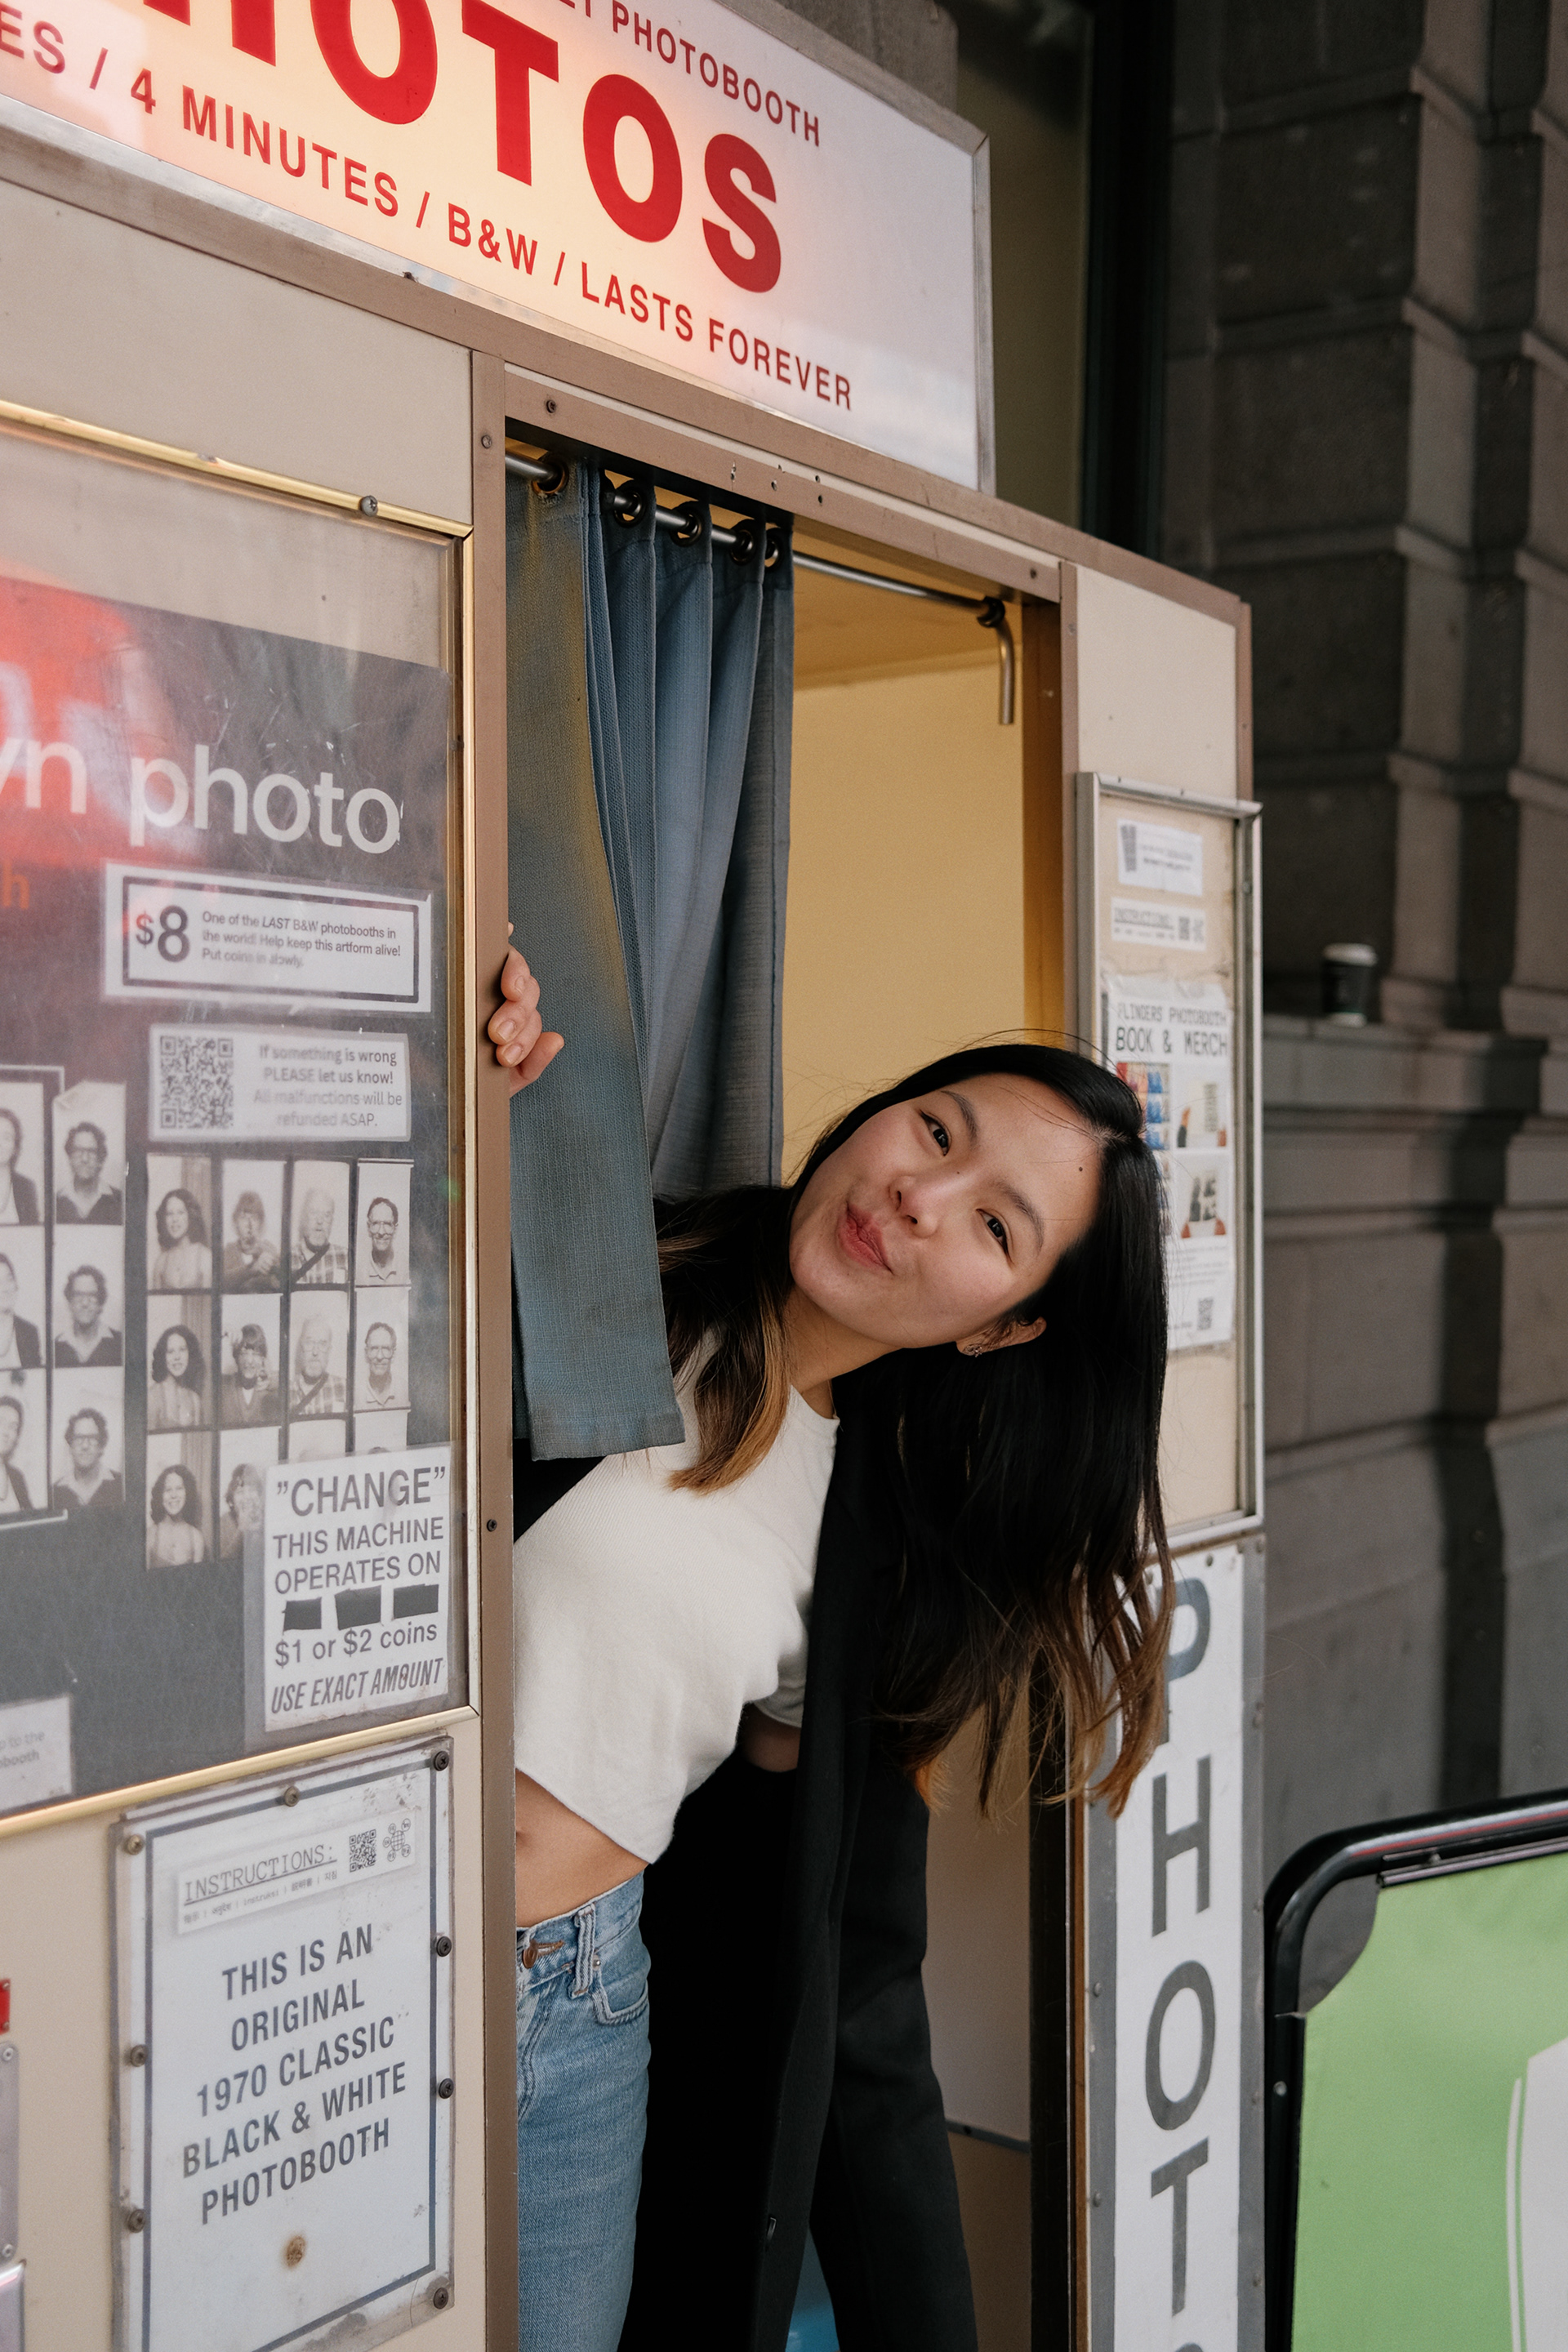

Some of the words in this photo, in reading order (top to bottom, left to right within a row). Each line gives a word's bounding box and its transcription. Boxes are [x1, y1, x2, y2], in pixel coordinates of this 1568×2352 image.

[612, 0, 819, 147] PHOTOBOOTH
[143, 0, 782, 294] OTOS
[131, 68, 157, 114] 4
[182, 85, 398, 217] MINUTES
[448, 203, 538, 275] B&W
[581, 261, 693, 342] LASTS
[709, 318, 852, 410] FOREVER
[131, 744, 400, 854] photo
[136, 905, 190, 963] $8
[203, 911, 225, 924] One
[229, 912, 239, 924] of
[242, 915, 259, 927] the
[262, 916, 290, 929] LAST
[293, 919, 318, 932] B&W
[321, 923, 385, 938] photobooths
[387, 928, 396, 939] in
[260, 934, 284, 948] Help
[287, 937, 312, 951] keep
[315, 939, 333, 951] this
[336, 942, 372, 955] artform
[376, 944, 401, 956] alive!
[202, 948, 221, 960] Put
[273, 1046, 342, 1065] something
[345, 1048, 355, 1062] is
[358, 1051, 398, 1067] wrong
[1116, 1026, 1153, 1053] BOOK
[1163, 1028, 1172, 1054] &
[1184, 1031, 1227, 1056] MERCH
[264, 1067, 315, 1082] PLEASE
[318, 1068, 336, 1083] let
[339, 1072, 354, 1084] us
[357, 1069, 394, 1085] know!
[363, 1091, 384, 1105] will
[387, 1091, 403, 1106] be
[340, 1112, 378, 1127] ASAP.
[273, 1529, 328, 1559] THIS
[336, 1517, 444, 1552] MACHINE
[274, 1556, 400, 1594] OPERATES
[408, 1551, 441, 1577] ON
[275, 1638, 301, 1668] $1
[313, 1639, 336, 1659] or
[343, 1628, 372, 1658] $2
[380, 1621, 437, 1649] coins
[271, 1682, 306, 1714] USE
[310, 1671, 369, 1707] EXACT
[370, 1657, 444, 1695] AMOUNT
[185, 1844, 333, 1902] INSTRUCTIONS:
[222, 1951, 288, 2002] THIS
[299, 1939, 326, 1979] IS
[336, 1922, 374, 1966] AN
[1145, 1577, 1216, 2352] PHOT
[230, 1979, 366, 2051] ORIGINAL
[196, 2066, 267, 2118] 1970
[279, 2015, 396, 2088] CLASSIC
[183, 2113, 280, 2179] BLACK
[292, 2102, 311, 2133] &
[323, 2060, 407, 2122] WHITE
[201, 2117, 390, 2225] PHOTOBOOTH
